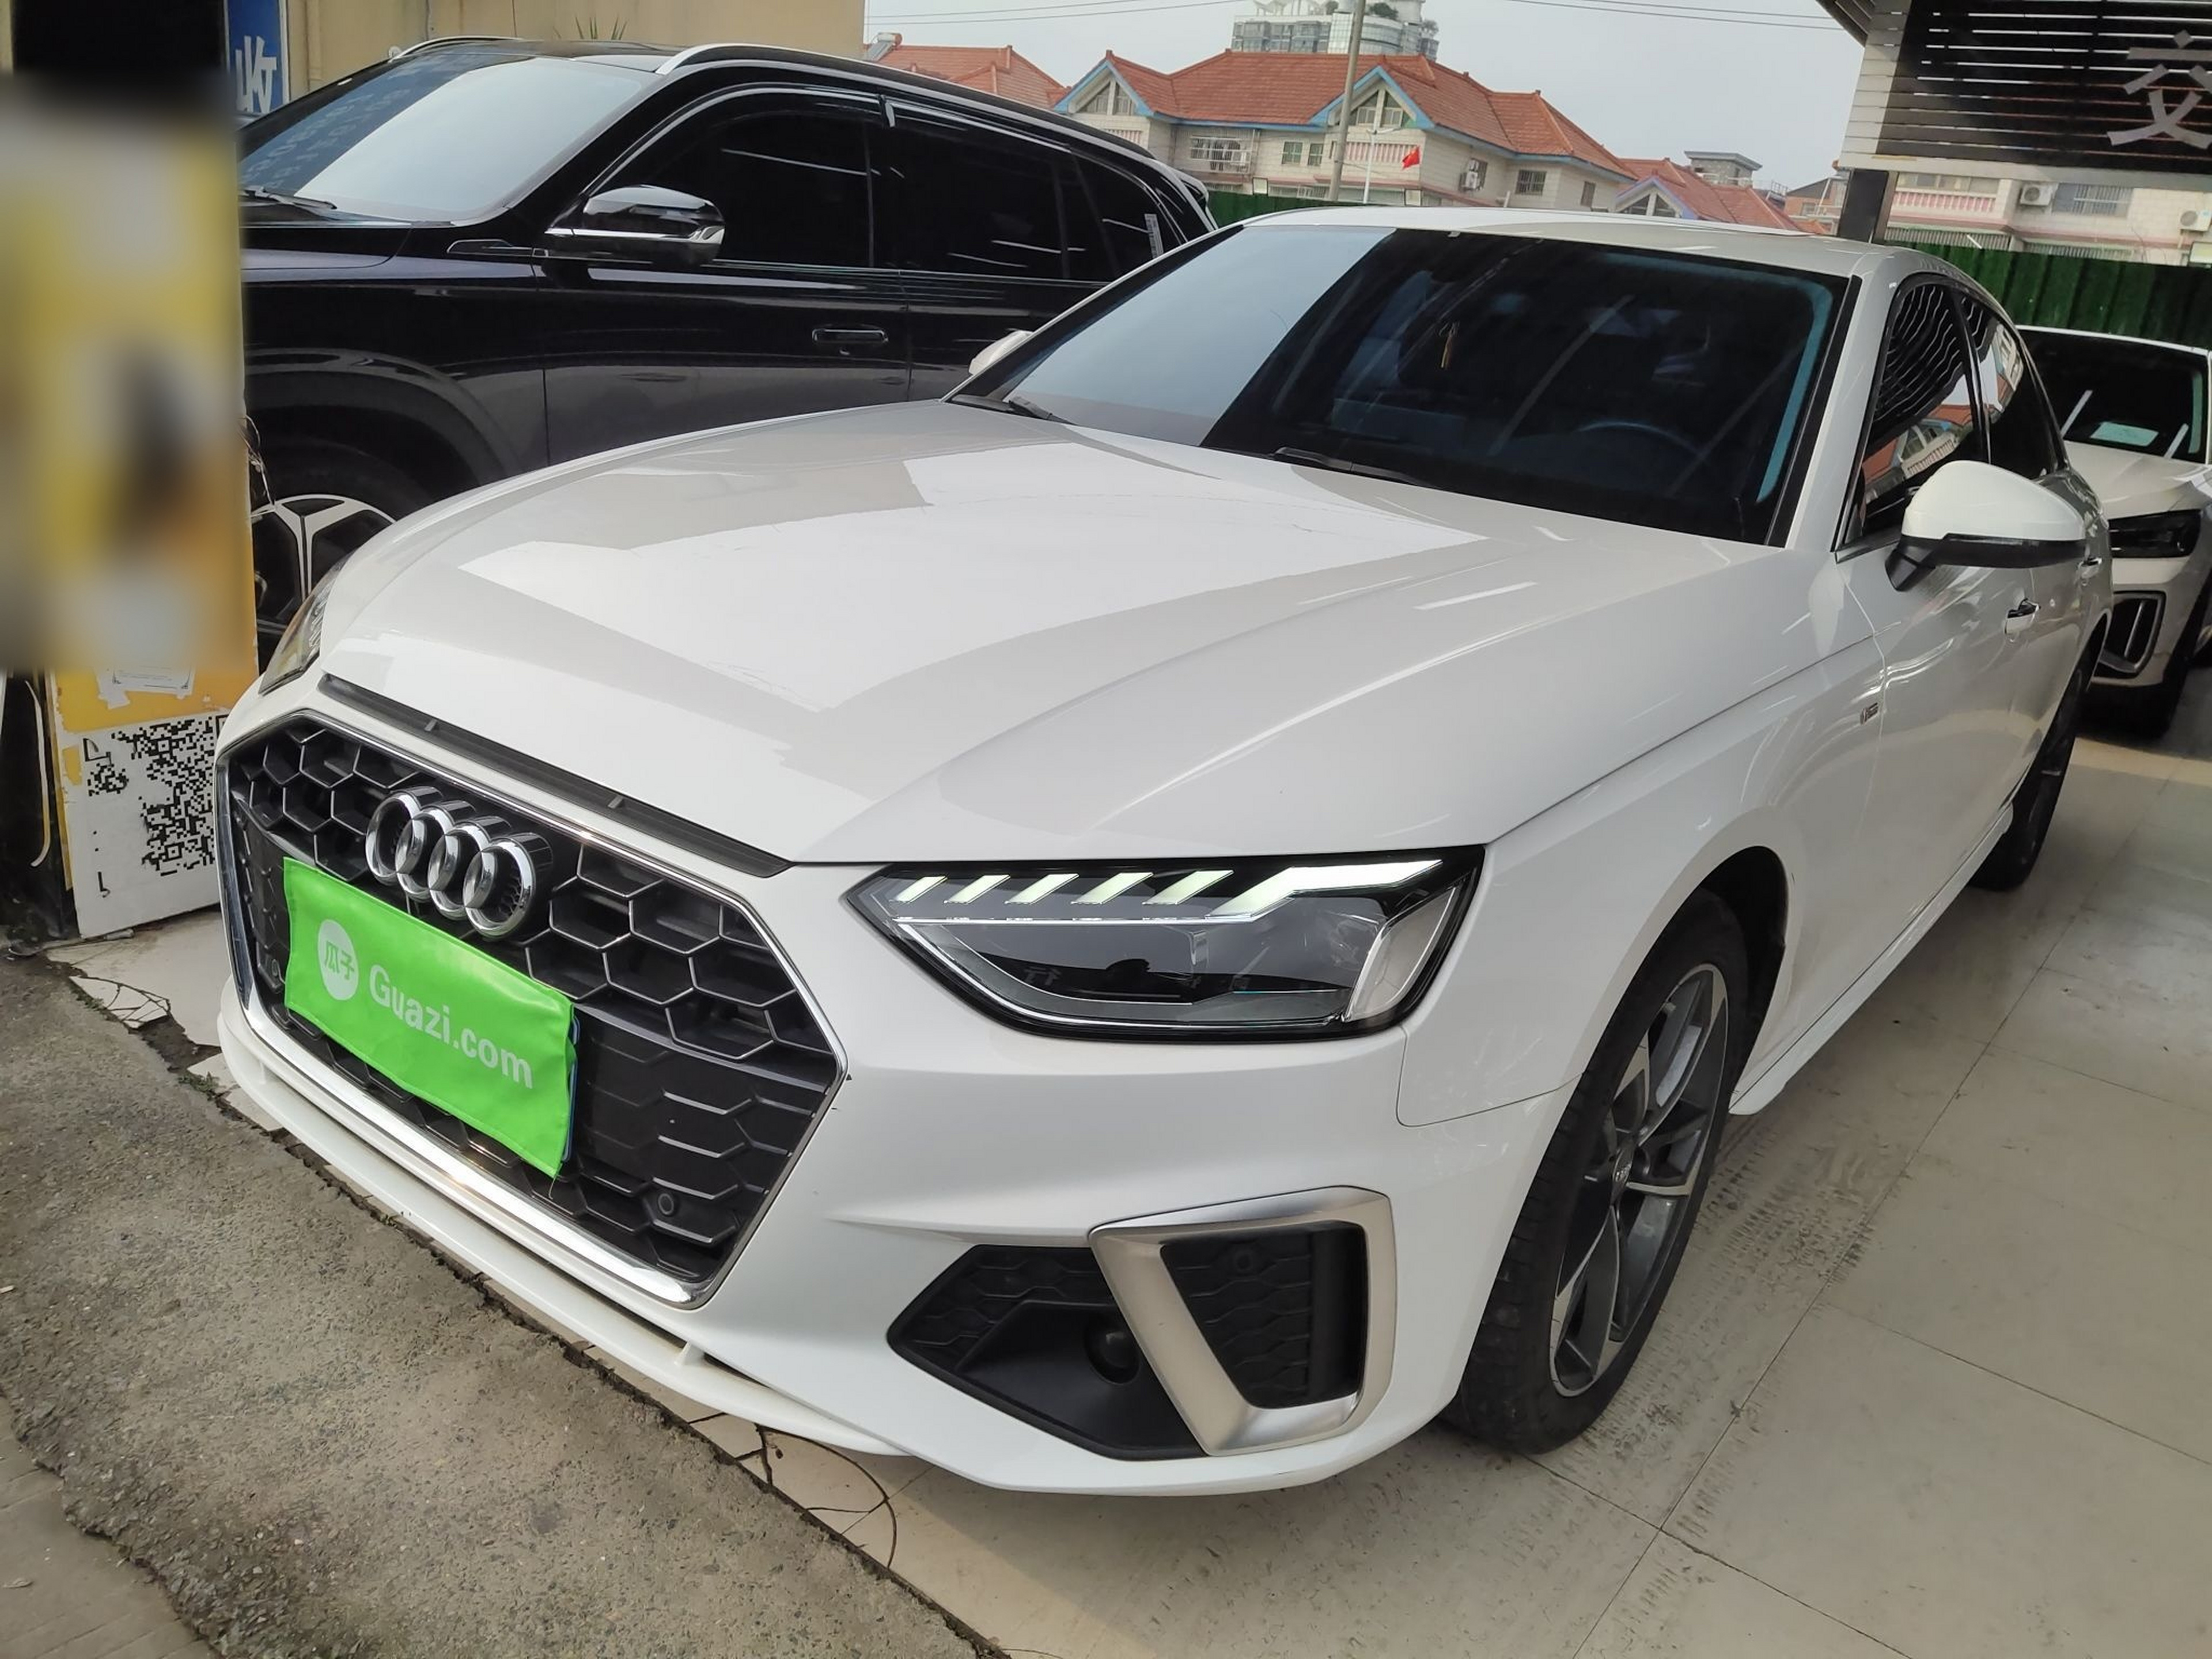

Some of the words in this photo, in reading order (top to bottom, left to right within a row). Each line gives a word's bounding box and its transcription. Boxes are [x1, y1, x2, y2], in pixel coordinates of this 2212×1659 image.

[2106, 29, 2212, 149] 交
[324, 940, 355, 981] 瓜子
[369, 964, 533, 1090] Guazi.com
